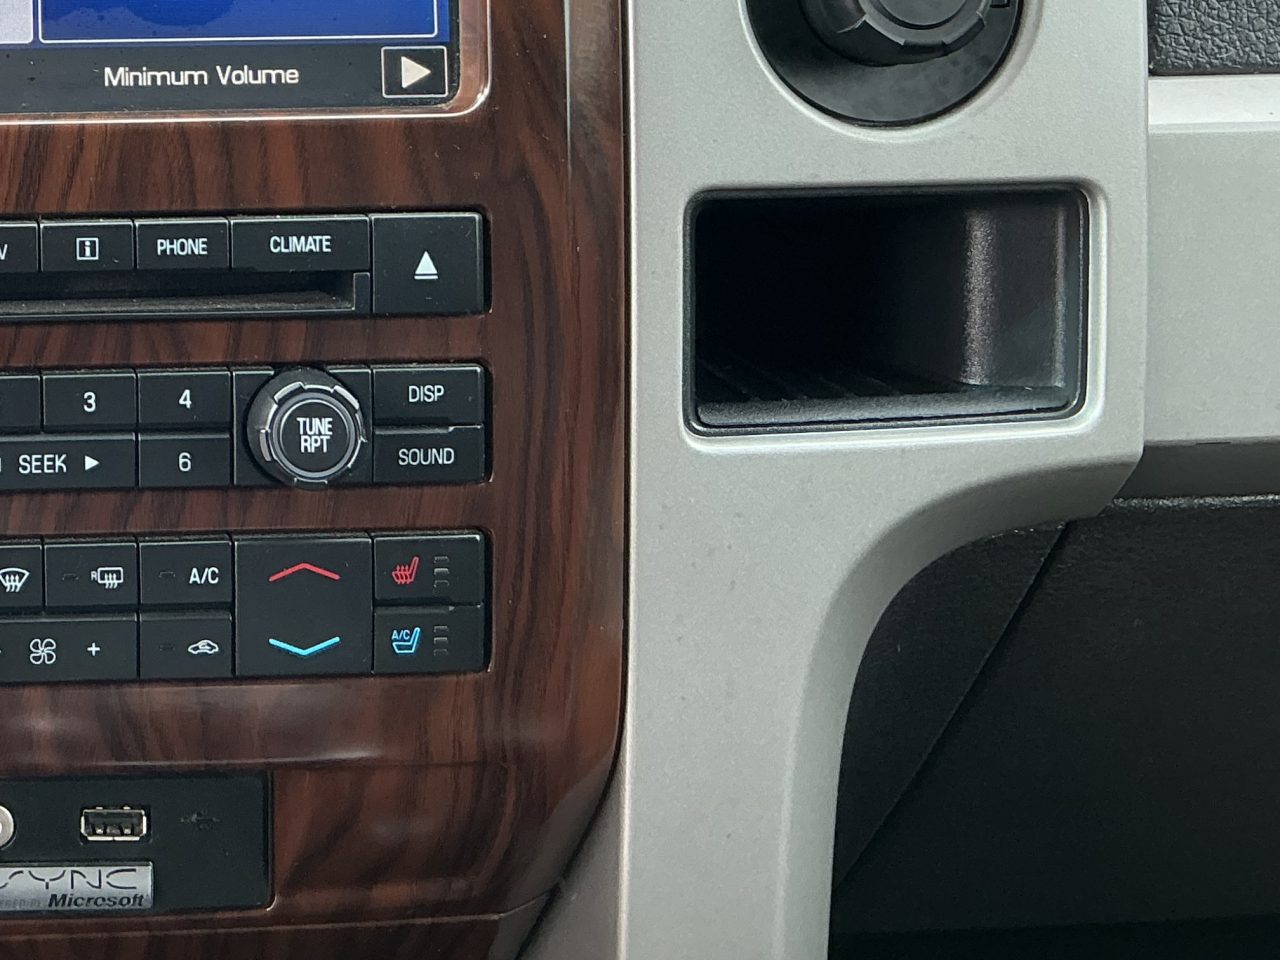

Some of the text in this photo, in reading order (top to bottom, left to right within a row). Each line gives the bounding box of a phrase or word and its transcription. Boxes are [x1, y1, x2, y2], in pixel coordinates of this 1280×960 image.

[104, 64, 300, 87] Minimum Volume
[156, 238, 208, 256] PHONE
[269, 235, 332, 253] CLIMATE
[83, 392, 97, 412] 3
[178, 389, 192, 409] 4
[408, 385, 445, 403] DISP
[296, 417, 333, 436] TUNE
[300, 435, 329, 453] RPT
[18, 454, 67, 474] SEEK
[178, 452, 192, 472] 6
[397, 448, 455, 466] SOUND
[189, 567, 220, 584] A/C
[391, 630, 410, 641] A/C
[48, 893, 145, 907] Microsoft
